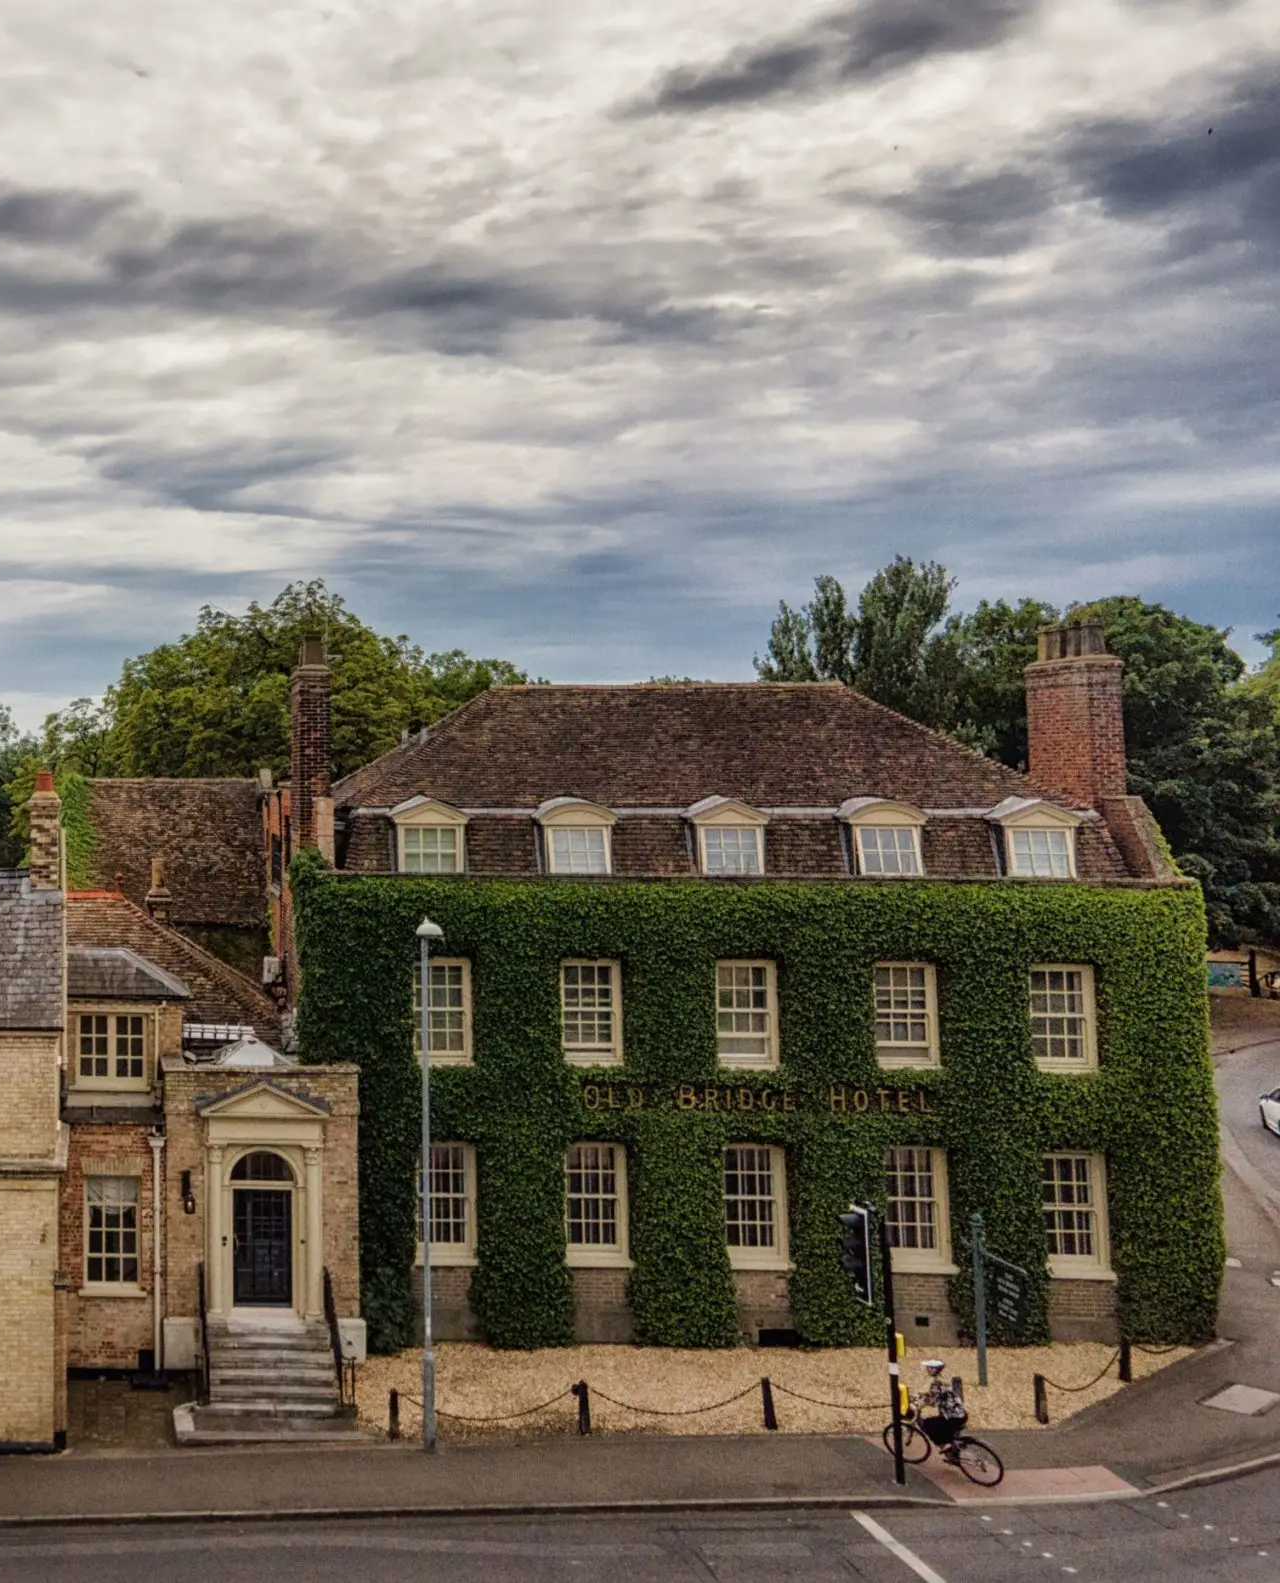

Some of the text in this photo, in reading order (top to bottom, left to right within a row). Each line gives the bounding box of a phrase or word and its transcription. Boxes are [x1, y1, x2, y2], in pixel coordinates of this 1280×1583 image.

[583, 1085, 933, 1113] OLD BRIDGE HOTEL
